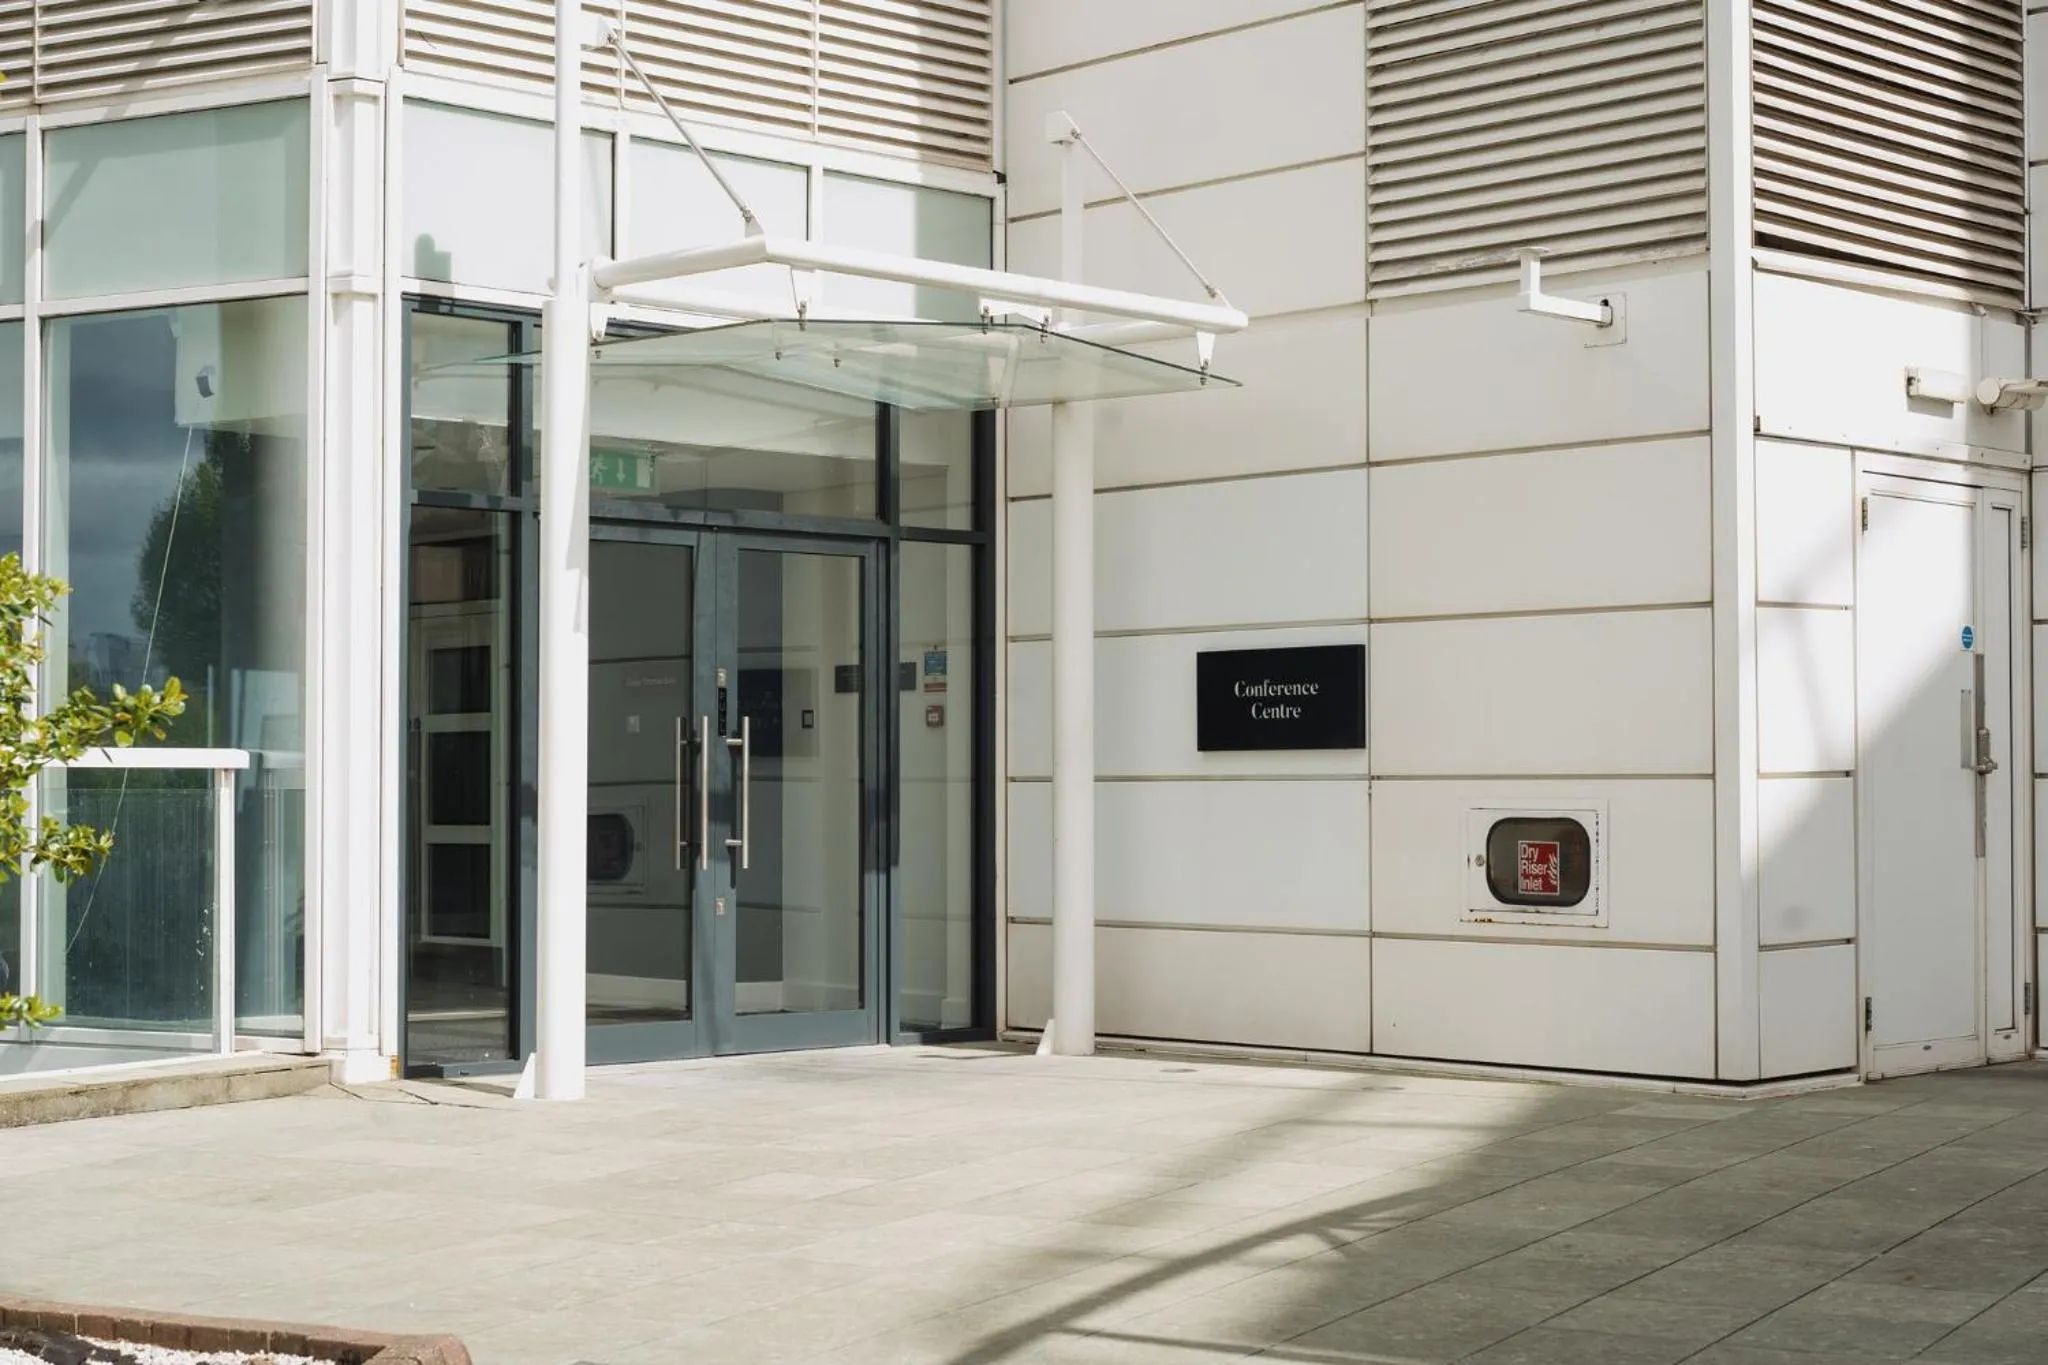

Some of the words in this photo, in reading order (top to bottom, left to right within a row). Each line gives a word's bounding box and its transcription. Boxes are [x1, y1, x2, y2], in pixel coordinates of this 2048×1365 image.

[1233, 679, 1320, 697] Conference
[1251, 702, 1302, 719] Centre
[1521, 844, 1539, 862] Dry
[1521, 861, 1548, 875] Riser
[1521, 877, 1543, 891] Inlet
